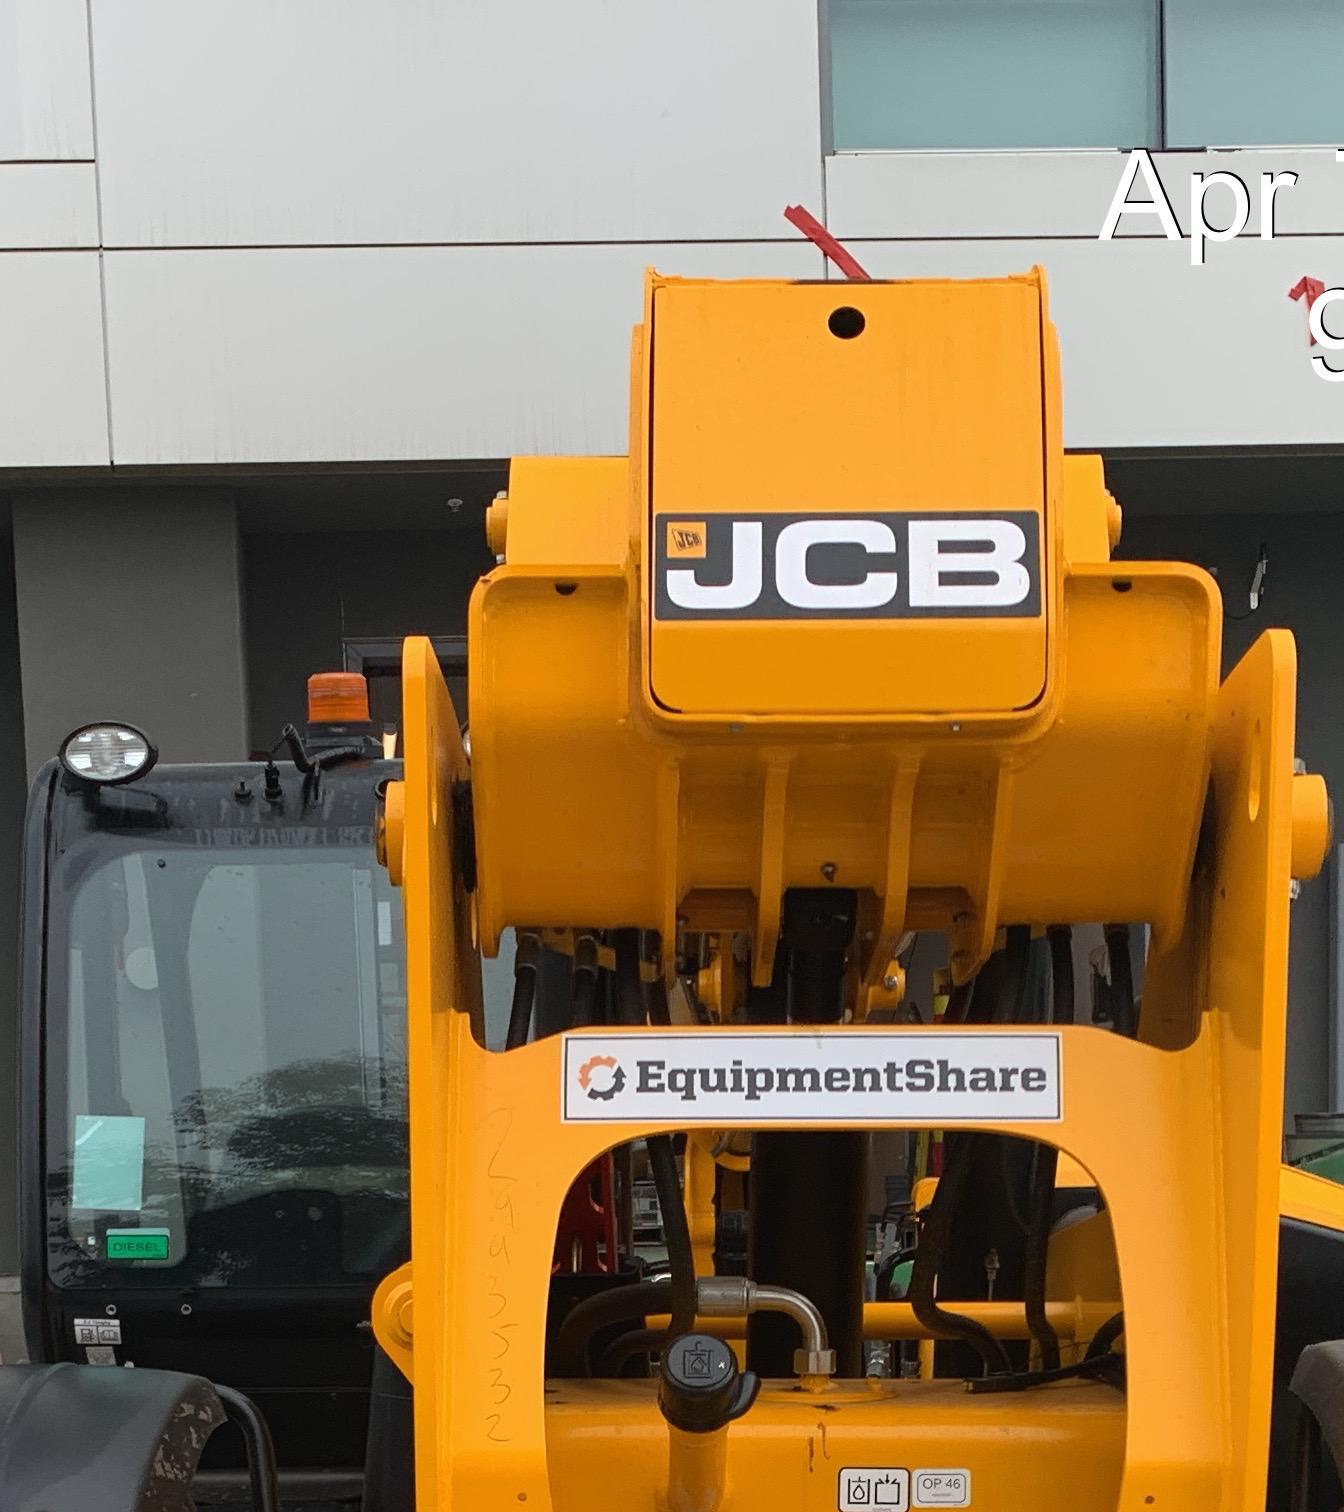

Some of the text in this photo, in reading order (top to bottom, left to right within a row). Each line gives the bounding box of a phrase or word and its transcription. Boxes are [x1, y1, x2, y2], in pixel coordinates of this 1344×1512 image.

[666, 519, 1032, 610] JCB
[636, 1058, 1047, 1101] EquipmentShare
[113, 1242, 162, 1253] DIESEL
[922, 1477, 961, 1490] OP 46
